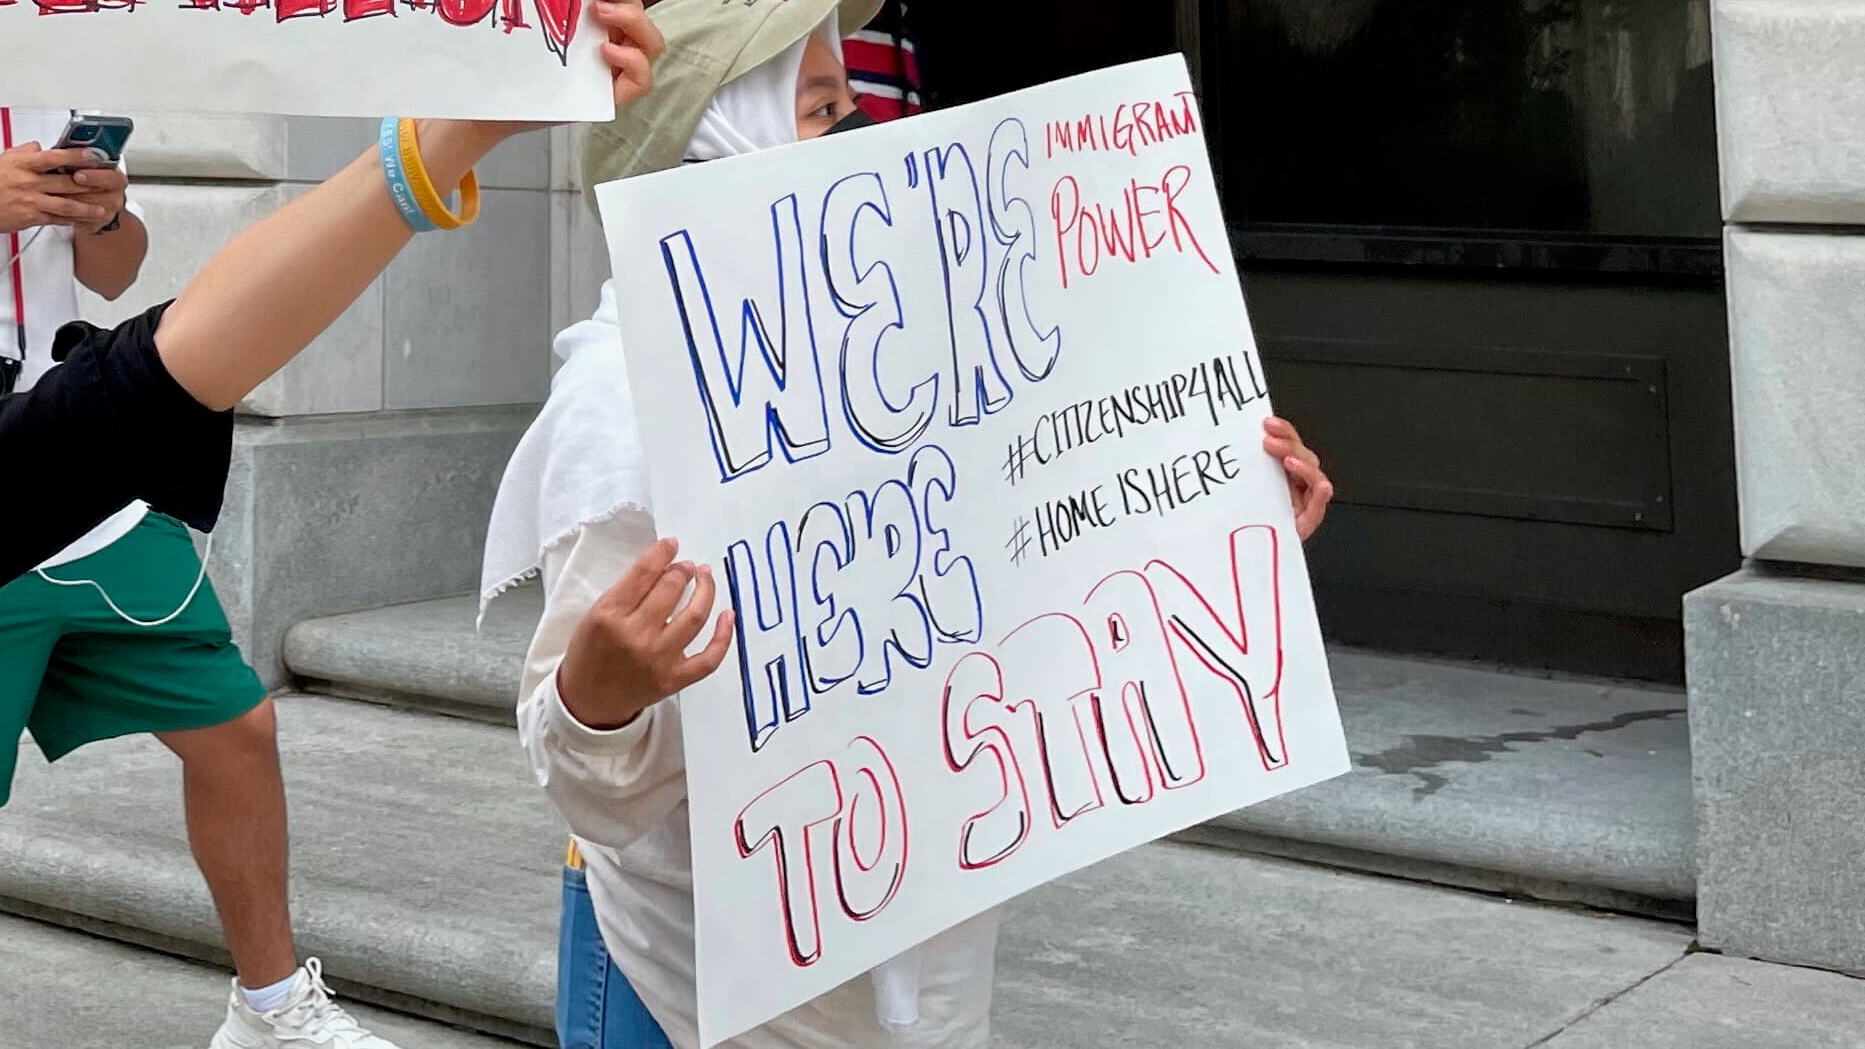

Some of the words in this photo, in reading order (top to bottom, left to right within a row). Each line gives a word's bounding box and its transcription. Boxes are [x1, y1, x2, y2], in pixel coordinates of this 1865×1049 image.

[661, 117, 1062, 483] WE'RE
[1045, 91, 1196, 159] IMMIGRANT
[1050, 165, 1221, 289] POWER
[1001, 351, 1270, 487] #CITIZENSHIP4ALL
[722, 445, 984, 753] HERE
[735, 735, 909, 969] TO
[940, 525, 1286, 870] STAY
